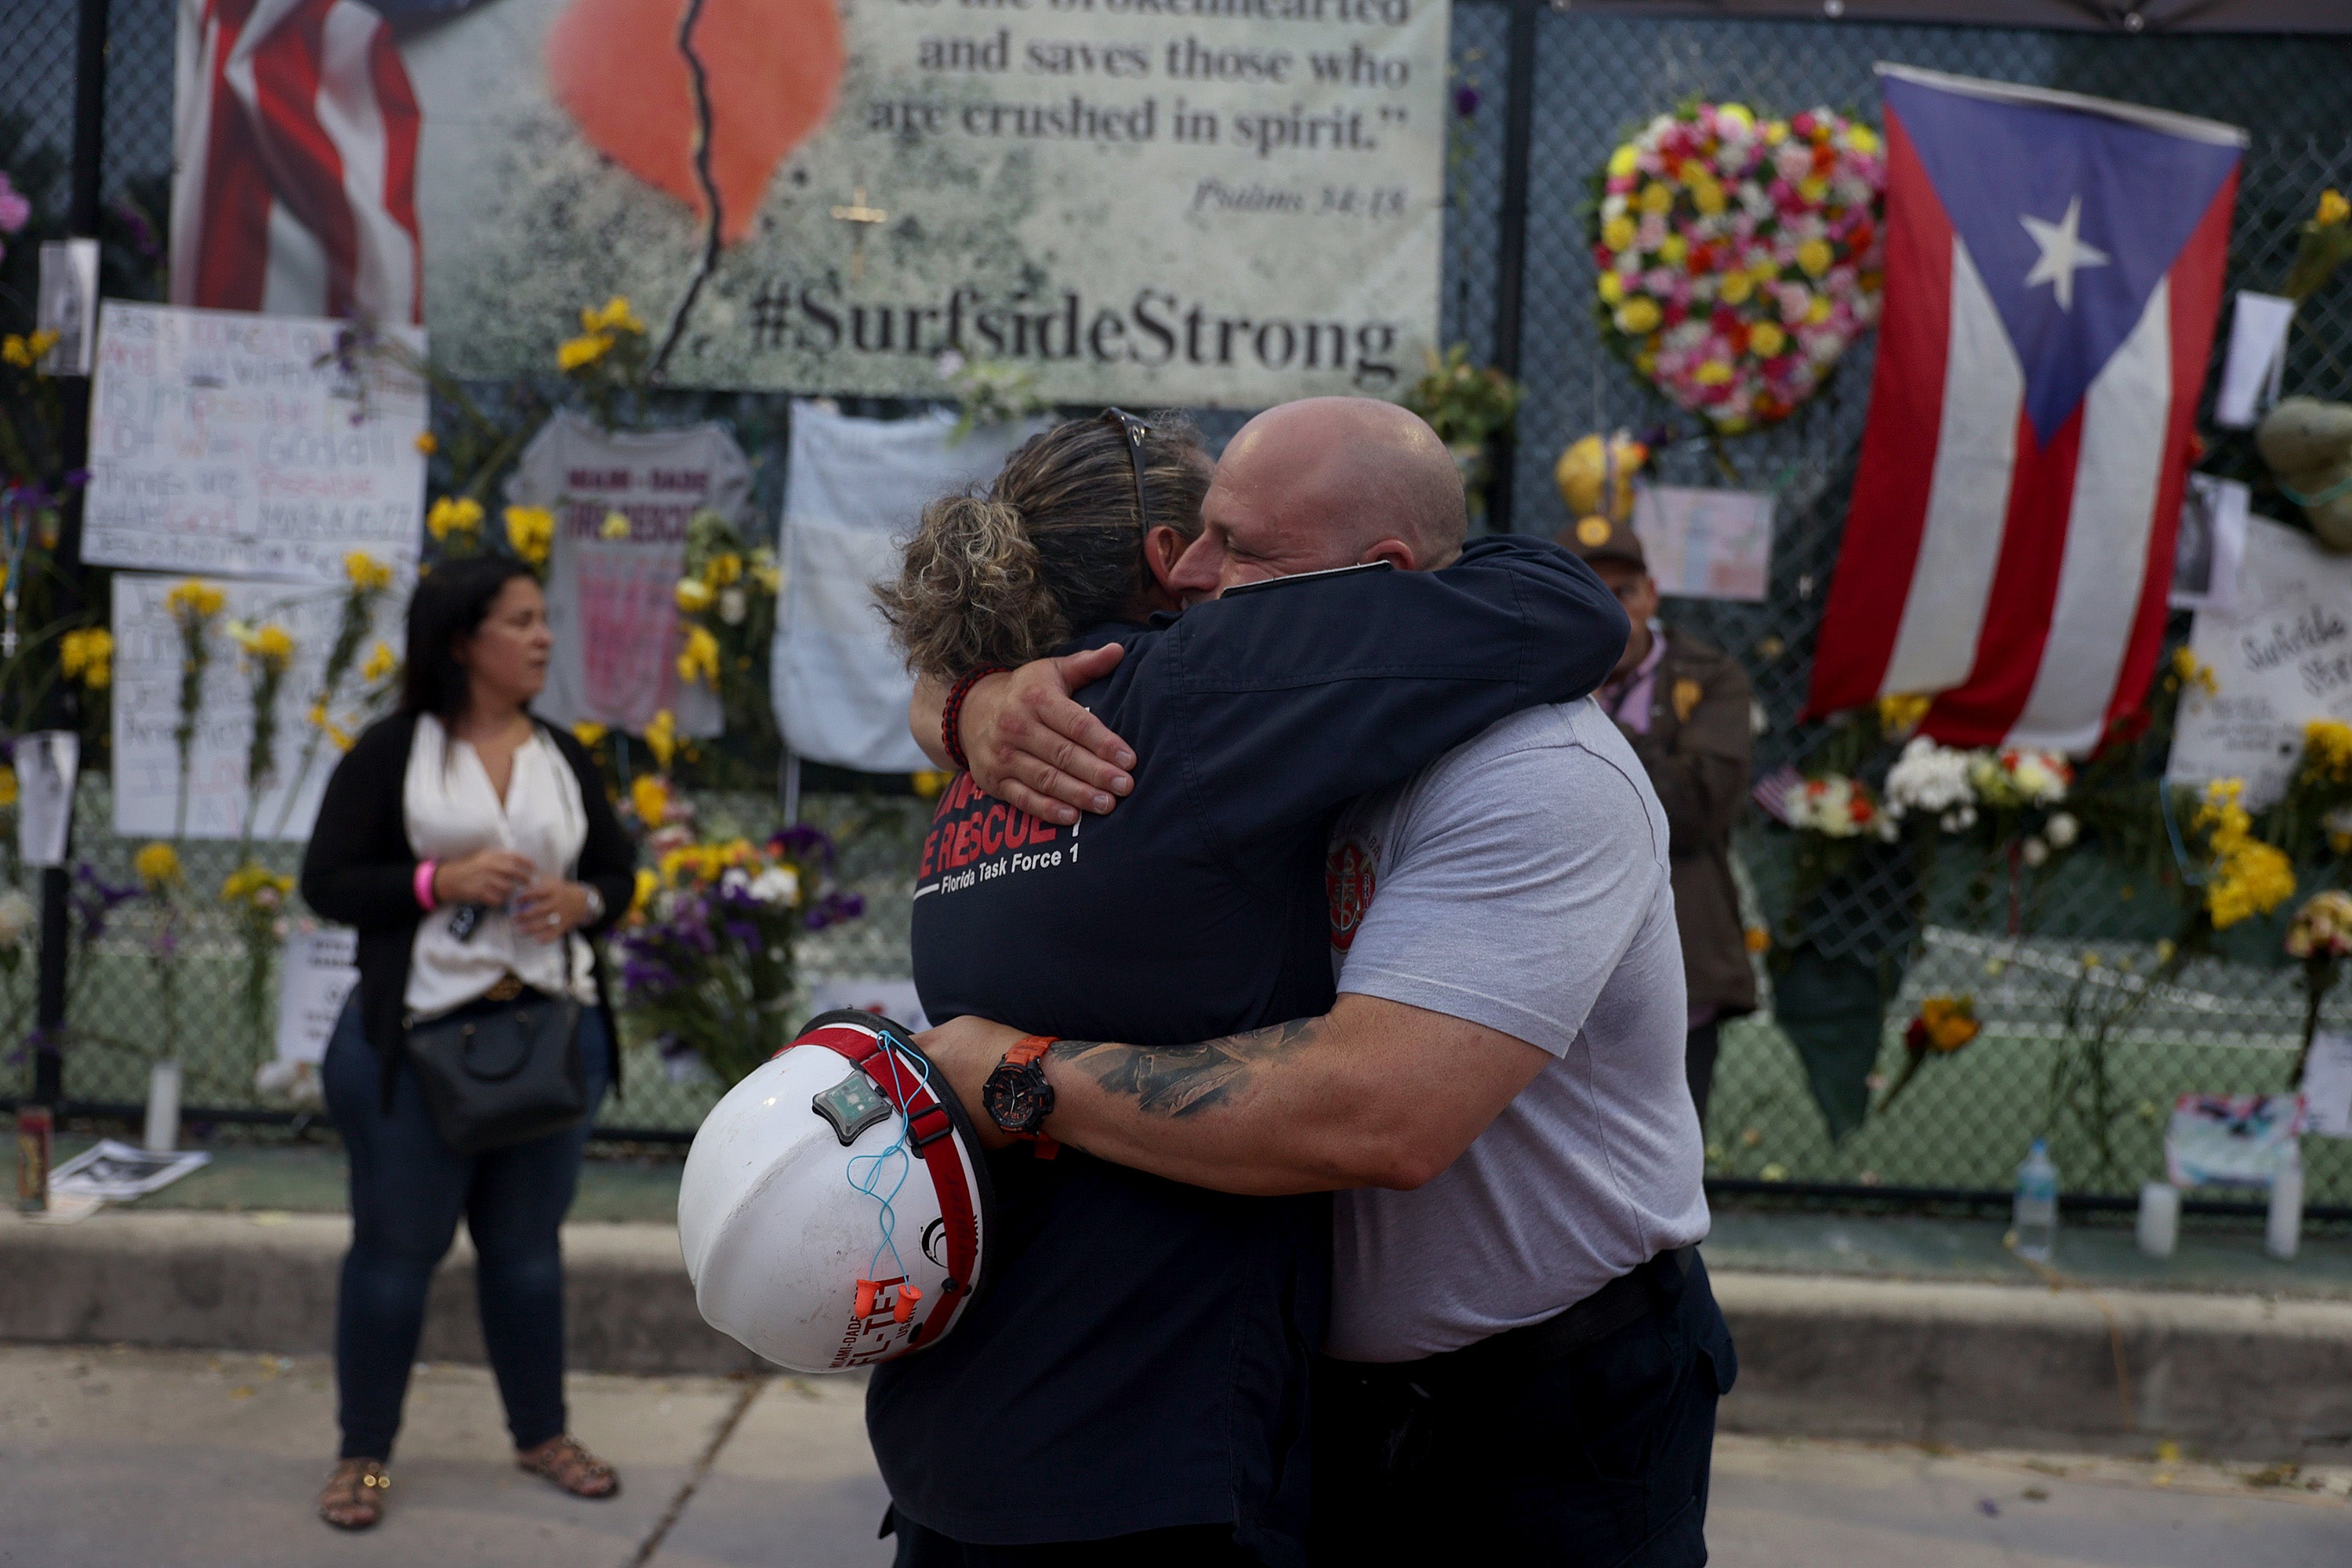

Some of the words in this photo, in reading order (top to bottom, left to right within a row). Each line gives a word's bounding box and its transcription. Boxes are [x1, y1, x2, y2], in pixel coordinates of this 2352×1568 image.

[919, 28, 1010, 72] and
[1026, 41, 1149, 78] saves
[1167, 34, 1293, 84] those
[1308, 42, 1410, 90] who
[870, 101, 946, 136] are
[962, 93, 1156, 140] crushed
[1174, 96, 1219, 144] in
[749, 283, 1401, 389] #SurfsideStrong
[941, 869, 975, 895] Florida
[979, 857, 1007, 883] Task
[1011, 848, 1062, 874] Force
[1069, 842, 1080, 863] 1
